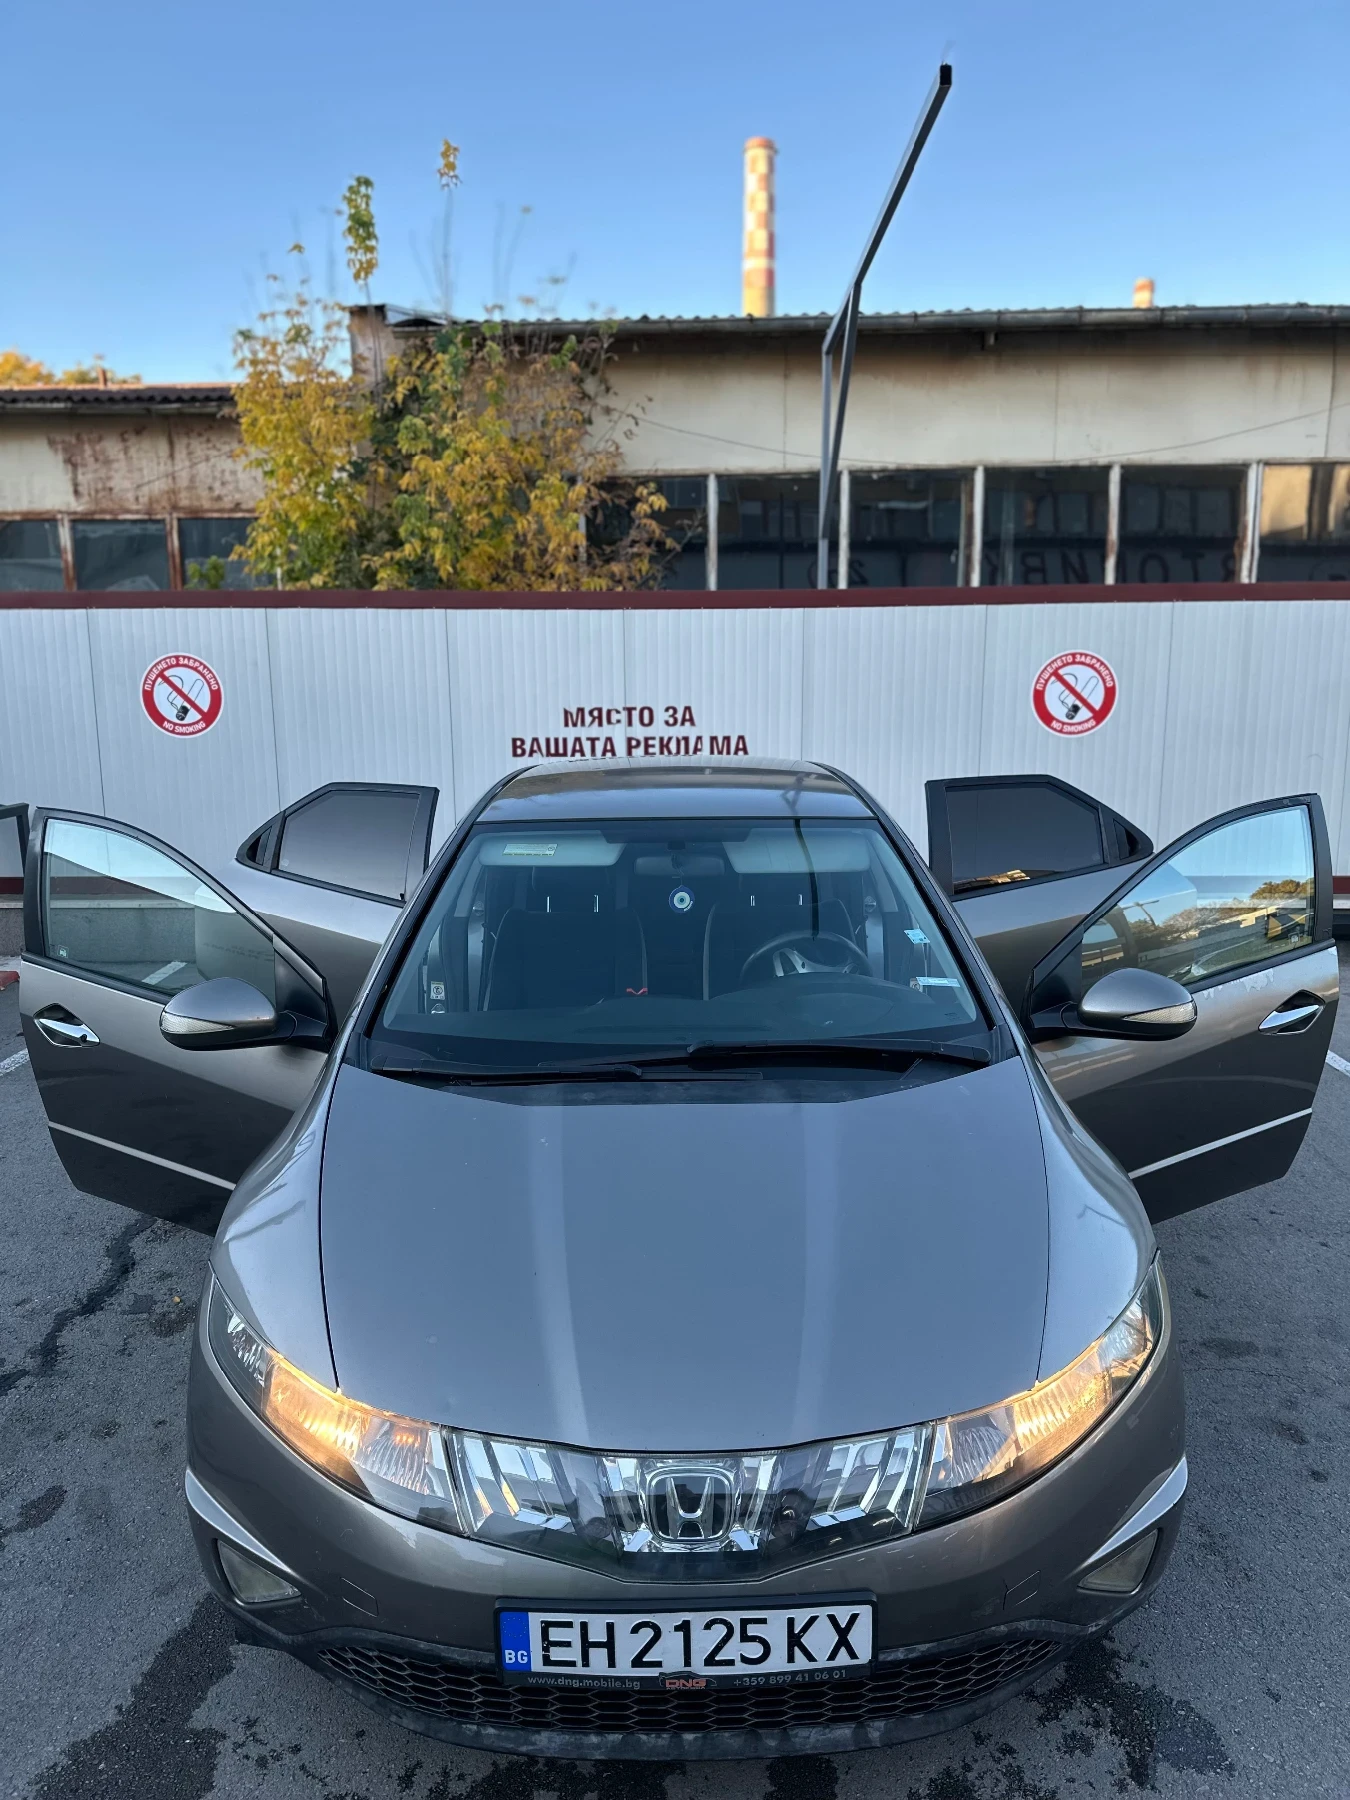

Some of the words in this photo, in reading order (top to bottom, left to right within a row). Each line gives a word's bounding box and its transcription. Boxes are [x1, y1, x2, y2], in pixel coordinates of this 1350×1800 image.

[145, 658, 176, 690] ПУШЕНЕТО
[178, 657, 218, 690] ЗАБРАНЕНО
[1036, 655, 1072, 690] ПУШЕНЕТО
[1075, 654, 1113, 687] ЗАБРАНЕНО
[563, 706, 655, 728] МЯСТО
[664, 705, 696, 728] ЗА
[163, 721, 173, 731] NO
[175, 721, 205, 733] SMOKING
[1051, 720, 1062, 730] NO
[1062, 719, 1096, 732] SMOKING
[511, 736, 618, 758] ВАШАТА
[626, 735, 749, 757] РЕКЛАМА
[540, 1619, 617, 1668] EH
[629, 1617, 771, 1669] 2125
[786, 1612, 861, 1664] KX
[505, 1650, 528, 1664] BG
[527, 1675, 641, 1690] www.dng.mobile.bg
[665, 1678, 707, 1688] DNG
[733, 1677, 766, 1686] +359
[769, 1674, 792, 1684] 899
[795, 1673, 810, 1682] 41
[814, 1672, 830, 1681] 06
[832, 1669, 847, 1679] 01
